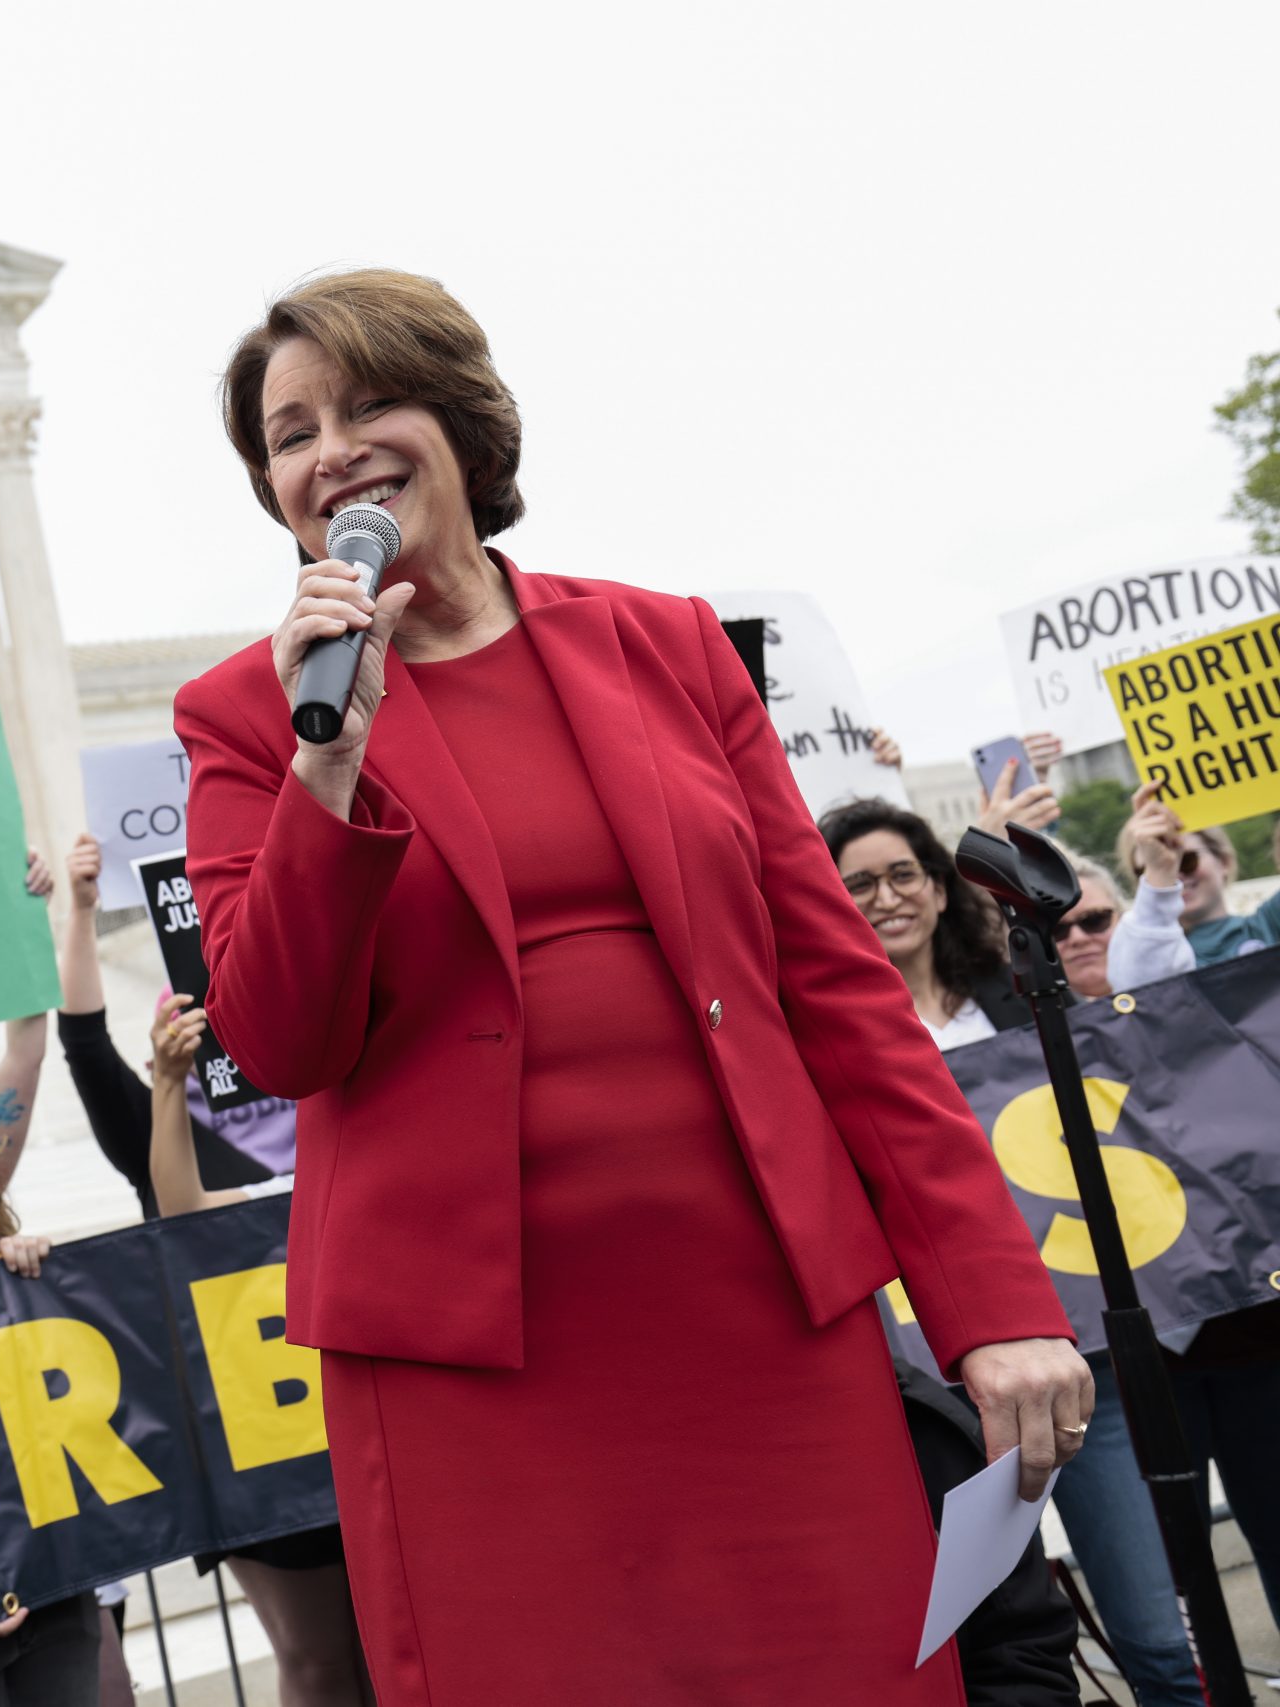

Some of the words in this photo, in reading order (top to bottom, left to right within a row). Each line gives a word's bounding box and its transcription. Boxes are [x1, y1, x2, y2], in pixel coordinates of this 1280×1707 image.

[1029, 565, 1280, 664] ABORTION
[1035, 669, 1070, 711] IS
[1132, 713, 1175, 756] IS
[1188, 702, 1218, 742] A
[121, 804, 187, 840] CO
[158, 876, 193, 907] AB
[210, 1074, 239, 1098] ALL
